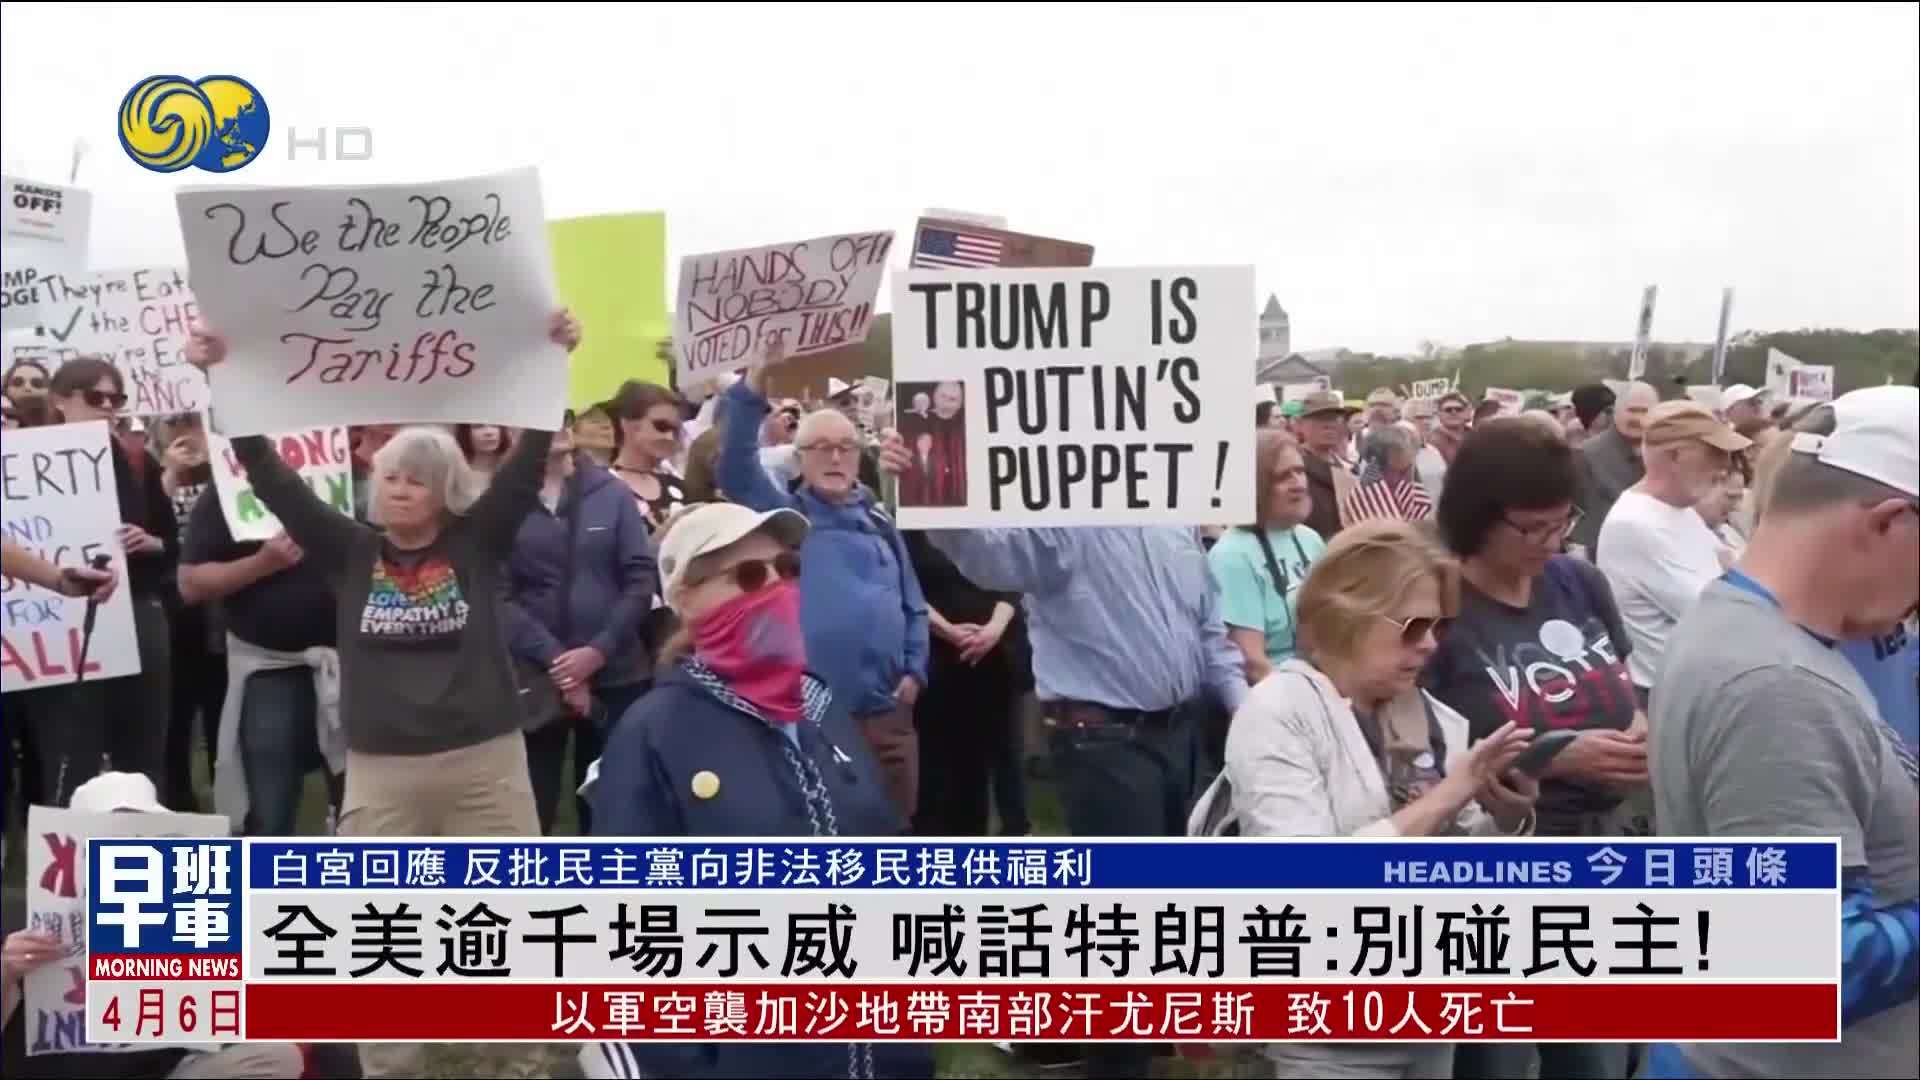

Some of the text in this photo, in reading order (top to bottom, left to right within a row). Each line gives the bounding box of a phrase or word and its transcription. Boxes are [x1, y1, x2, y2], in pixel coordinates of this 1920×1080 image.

[205, 193, 511, 264] We the People
[284, 264, 496, 331] Pay the
[692, 242, 809, 297] HANDS
[687, 272, 857, 333] NOBODY
[908, 276, 1198, 350] TRUMP IS
[281, 330, 476, 384] Tariffs
[684, 323, 750, 371] VOTED
[984, 356, 1201, 435] PUTIN'S
